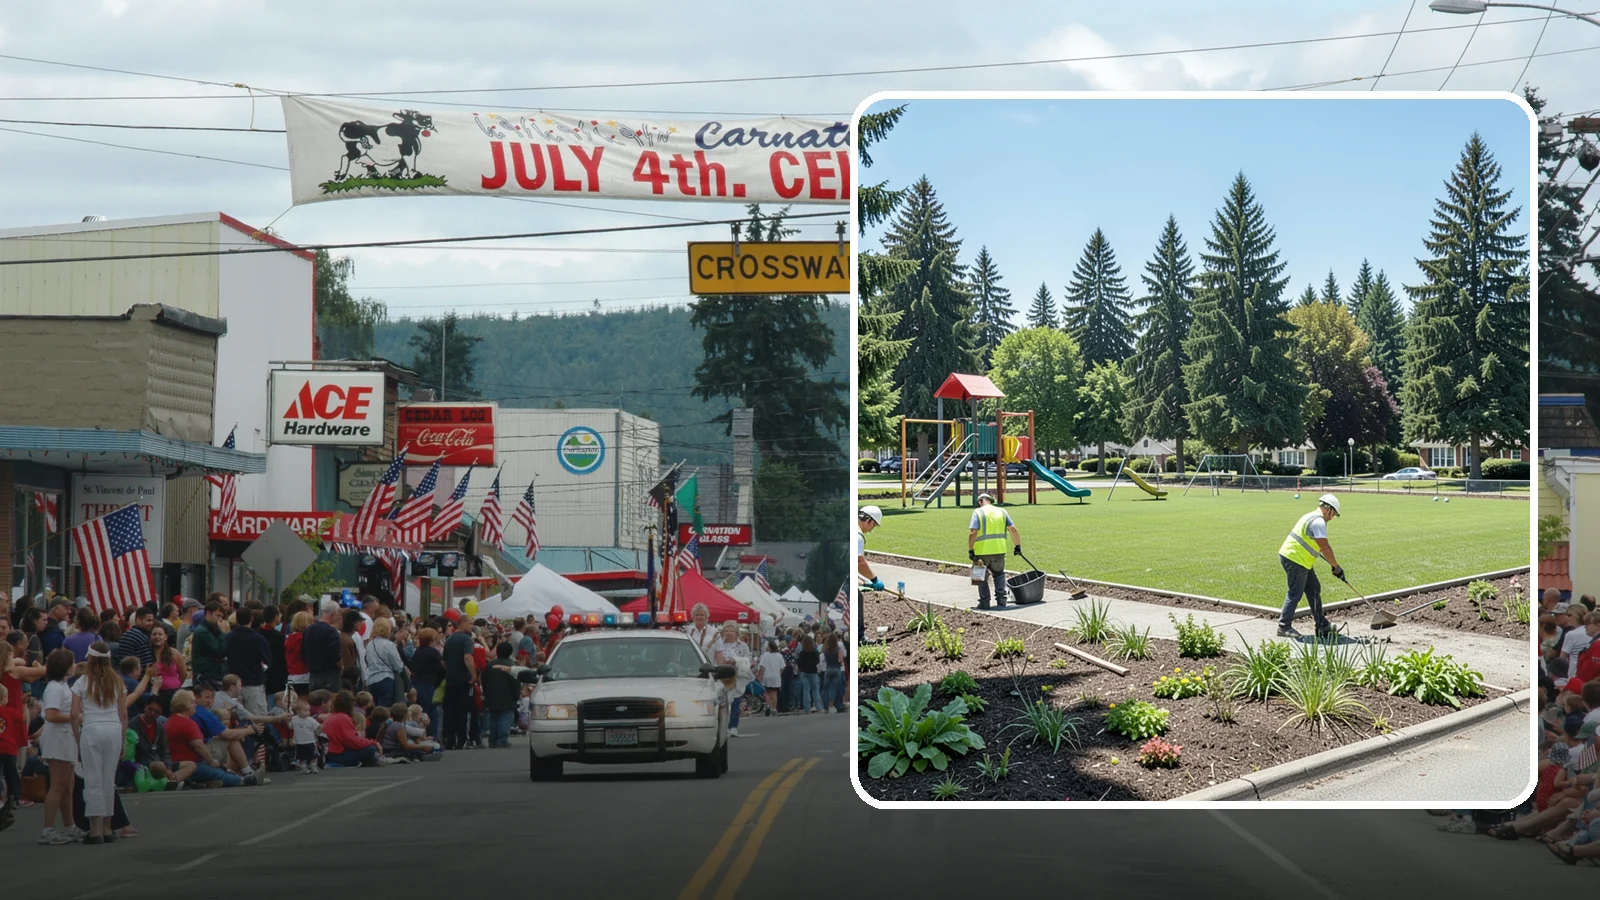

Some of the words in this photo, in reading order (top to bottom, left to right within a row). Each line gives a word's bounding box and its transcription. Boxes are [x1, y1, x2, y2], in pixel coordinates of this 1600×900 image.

[481, 141, 605, 192] JULY
[632, 150, 746, 198] 4th.
[697, 254, 850, 280] CROSSWA
[283, 380, 373, 420] ACE
[405, 410, 453, 422] CEDAR
[283, 421, 371, 436] Hardware
[416, 428, 477, 447] Coca-Cola
[95, 485, 124, 495] Vincent
[126, 486, 136, 495] de
[137, 486, 155, 495] Paul
[688, 526, 741, 535] CRNATION
[699, 535, 730, 543] GLASS
